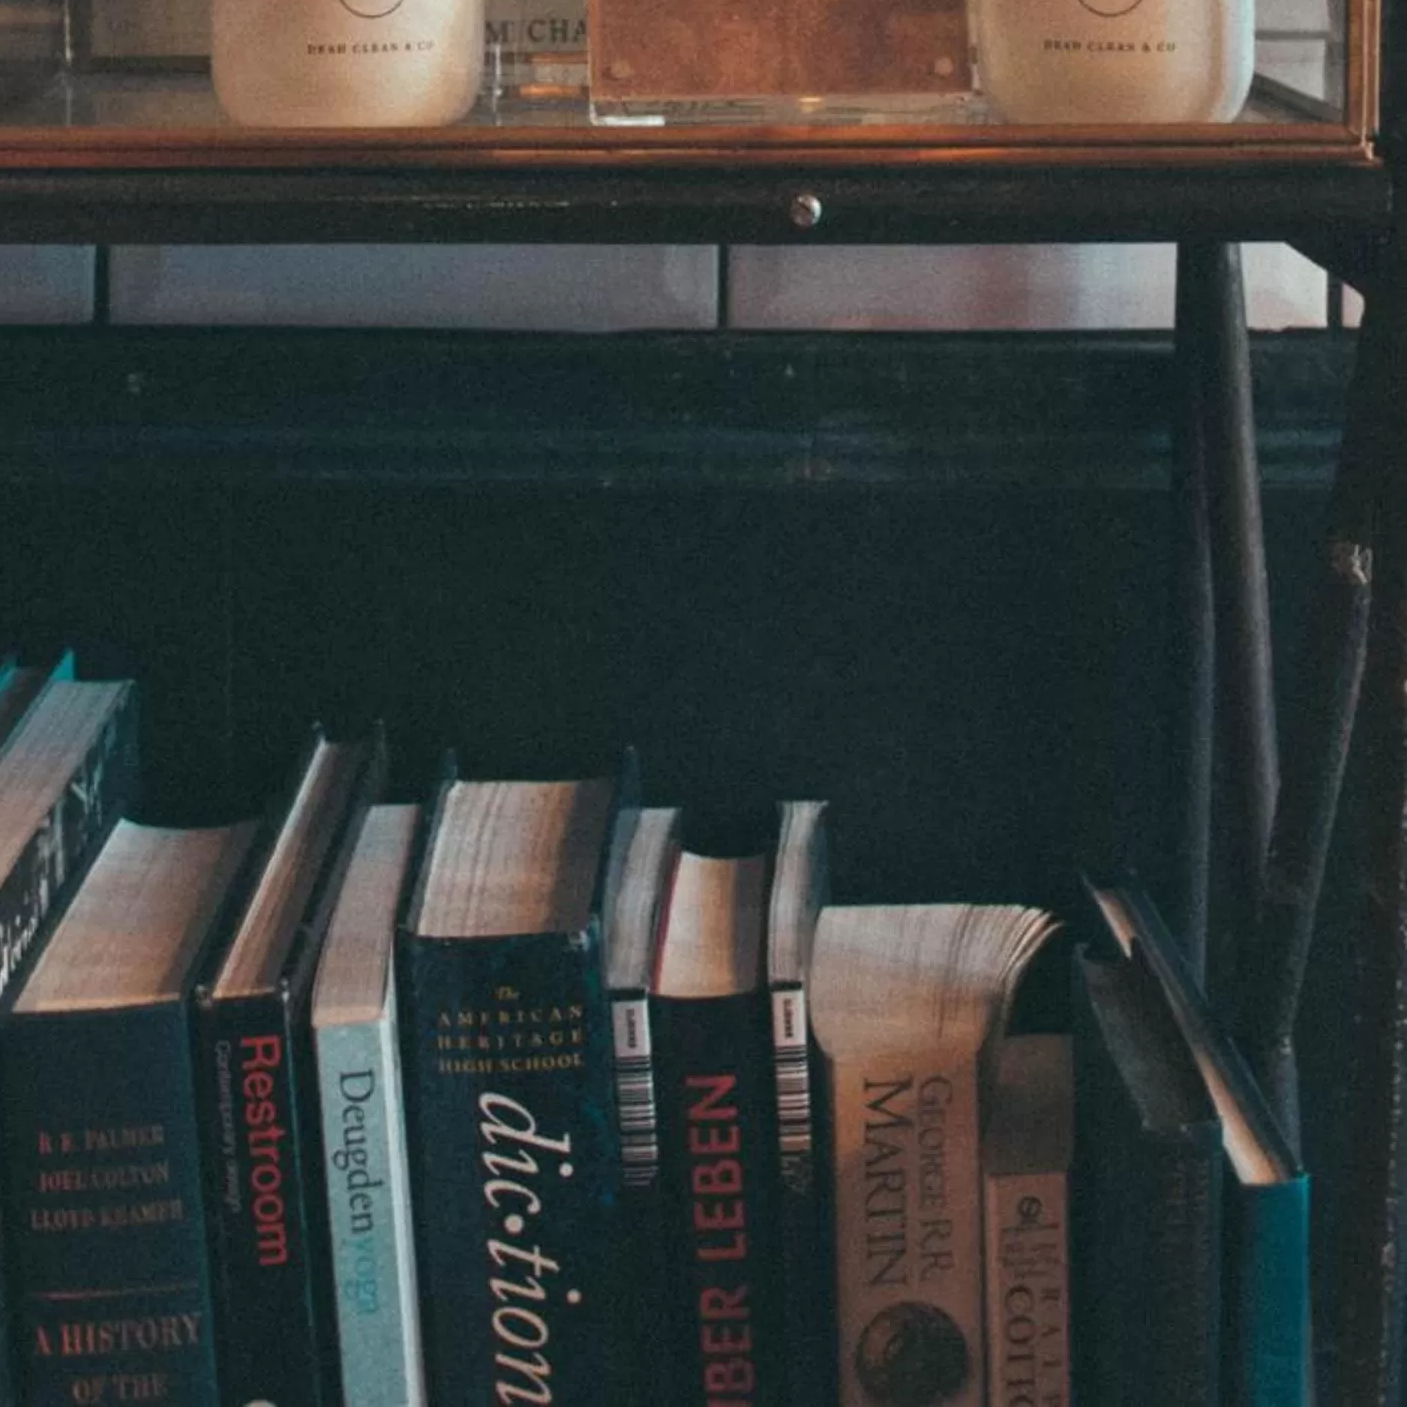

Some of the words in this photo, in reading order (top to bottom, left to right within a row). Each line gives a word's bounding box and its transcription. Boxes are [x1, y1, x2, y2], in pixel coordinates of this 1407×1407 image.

[306, 42, 346, 55] DEAD
[351, 42, 400, 54] CLEAN
[1043, 41, 1082, 53] DEAD
[1086, 41, 1136, 53] CLEAN
[438, 1003, 584, 1028] AMERICAN
[436, 1026, 584, 1051] HERITAGE
[438, 1054, 496, 1074] HIGH
[498, 1051, 584, 1073] SCHOOL
[213, 1038, 240, 1157] Contemporary
[84, 1123, 167, 1152] PALMER
[240, 1032, 290, 1267] Restroom
[917, 1075, 955, 1211] GEORGE
[38, 1168, 87, 1193] JOEL
[92, 1160, 170, 1190] COLTON
[683, 1072, 752, 1262] LEBEN
[863, 1075, 916, 1292] MARTIN
[100, 1198, 184, 1229] KRAMER
[34, 1322, 54, 1357] A
[59, 1311, 204, 1356] HISTORY
[698, 1285, 760, 1407] BER
[70, 1374, 107, 1406] OF
[111, 1372, 171, 1402] THE
